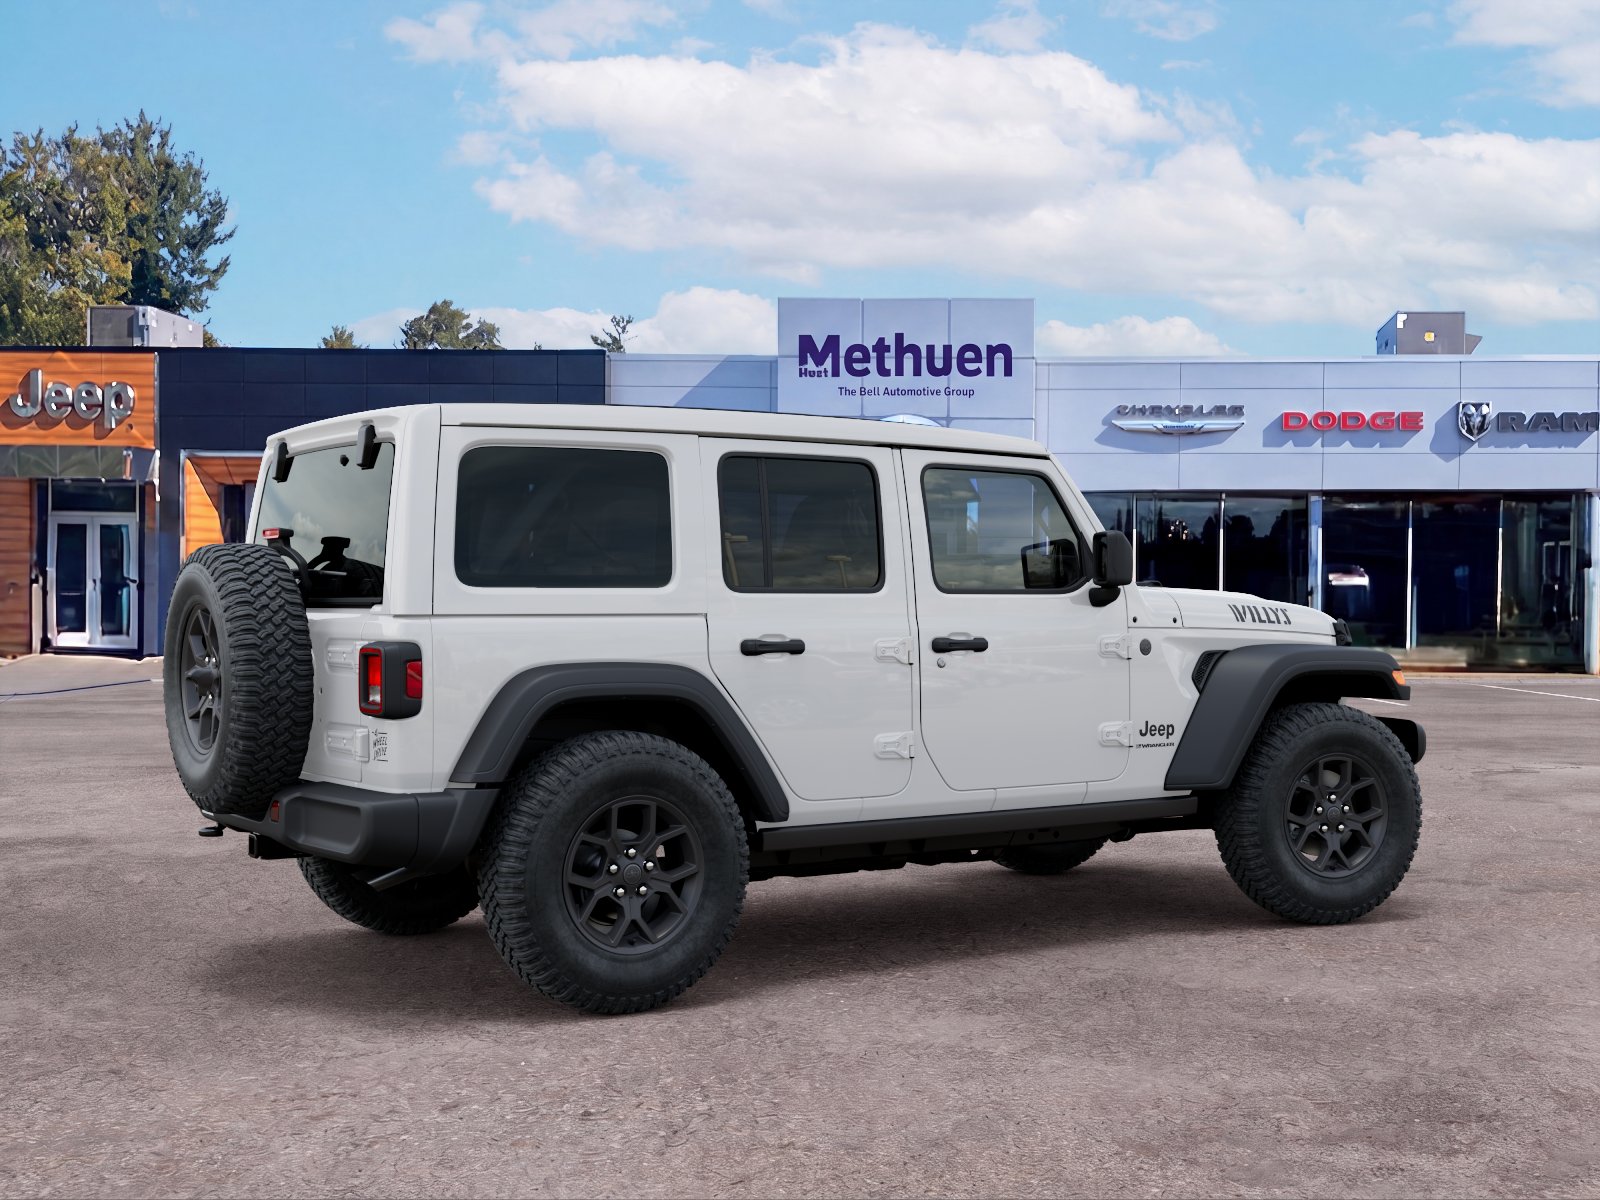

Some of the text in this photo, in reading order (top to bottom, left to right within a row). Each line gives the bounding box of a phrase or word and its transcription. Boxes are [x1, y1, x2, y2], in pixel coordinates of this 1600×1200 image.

[799, 333, 1012, 377] Methuen
[9, 368, 136, 429] Jeep
[838, 387, 975, 398] The Bell Automotive Group
[1282, 411, 1424, 431] DODGE
[1498, 412, 1599, 431] RAM
[1228, 604, 1291, 624] WILLYS
[1139, 721, 1175, 739] Jeep
